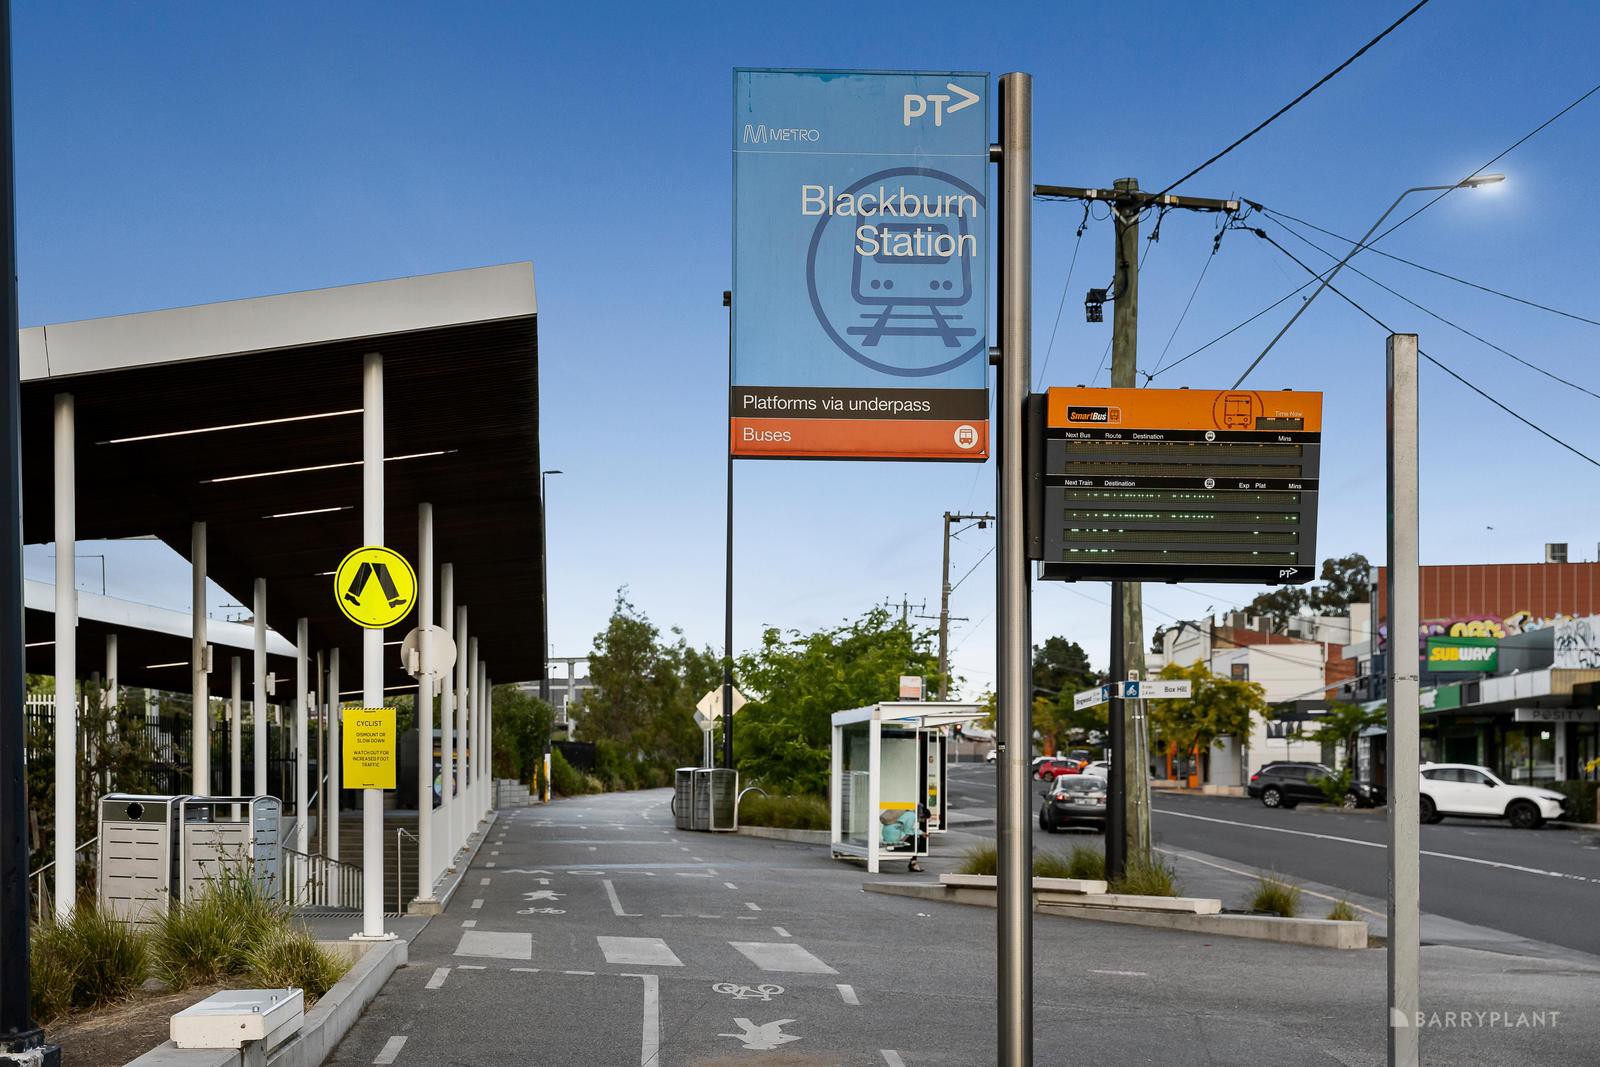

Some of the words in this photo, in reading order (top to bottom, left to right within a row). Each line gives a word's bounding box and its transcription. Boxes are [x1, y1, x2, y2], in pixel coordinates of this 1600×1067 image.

[770, 128, 820, 142] METRO
[801, 184, 978, 218] Blackburn
[855, 224, 978, 258] Station
[743, 394, 817, 411] Platforms
[822, 396, 844, 411] via
[849, 397, 931, 415] underpass
[1070, 411, 1108, 421] SmartBus
[743, 427, 792, 442] Buses
[1239, 482, 1250, 490] Exp
[1430, 647, 1496, 661] SUBWAY
